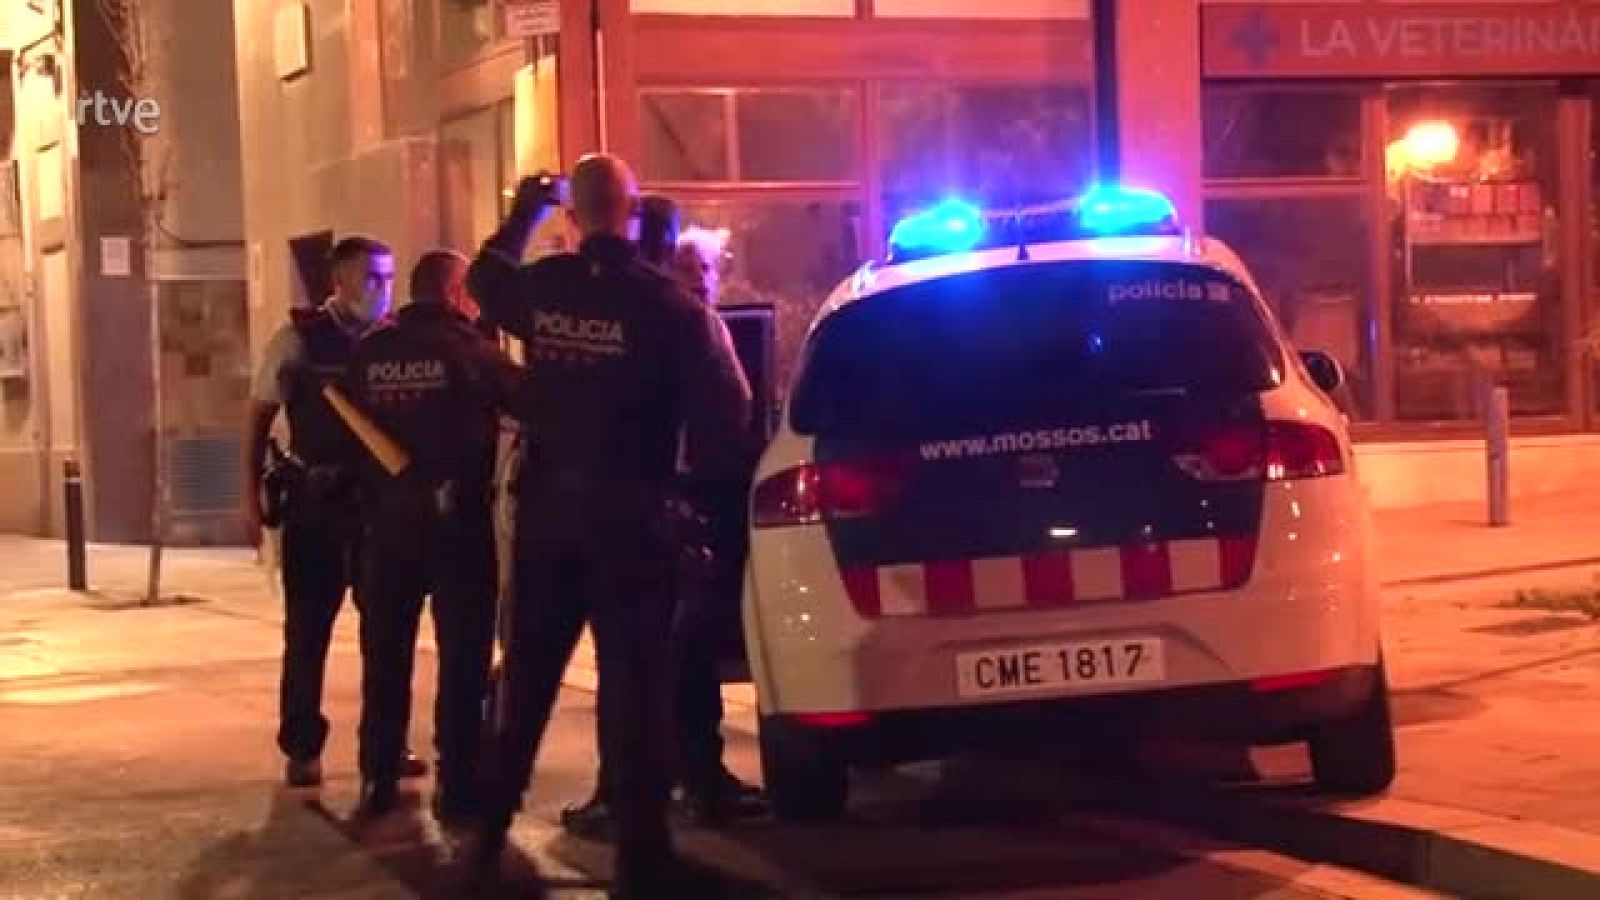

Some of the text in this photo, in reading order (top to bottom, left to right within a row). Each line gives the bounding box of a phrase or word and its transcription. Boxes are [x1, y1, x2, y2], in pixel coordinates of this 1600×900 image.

[1302, 18, 1357, 58] LA
[920, 419, 1152, 461] www.mossos.cat
[974, 644, 1144, 689] CME 1817
